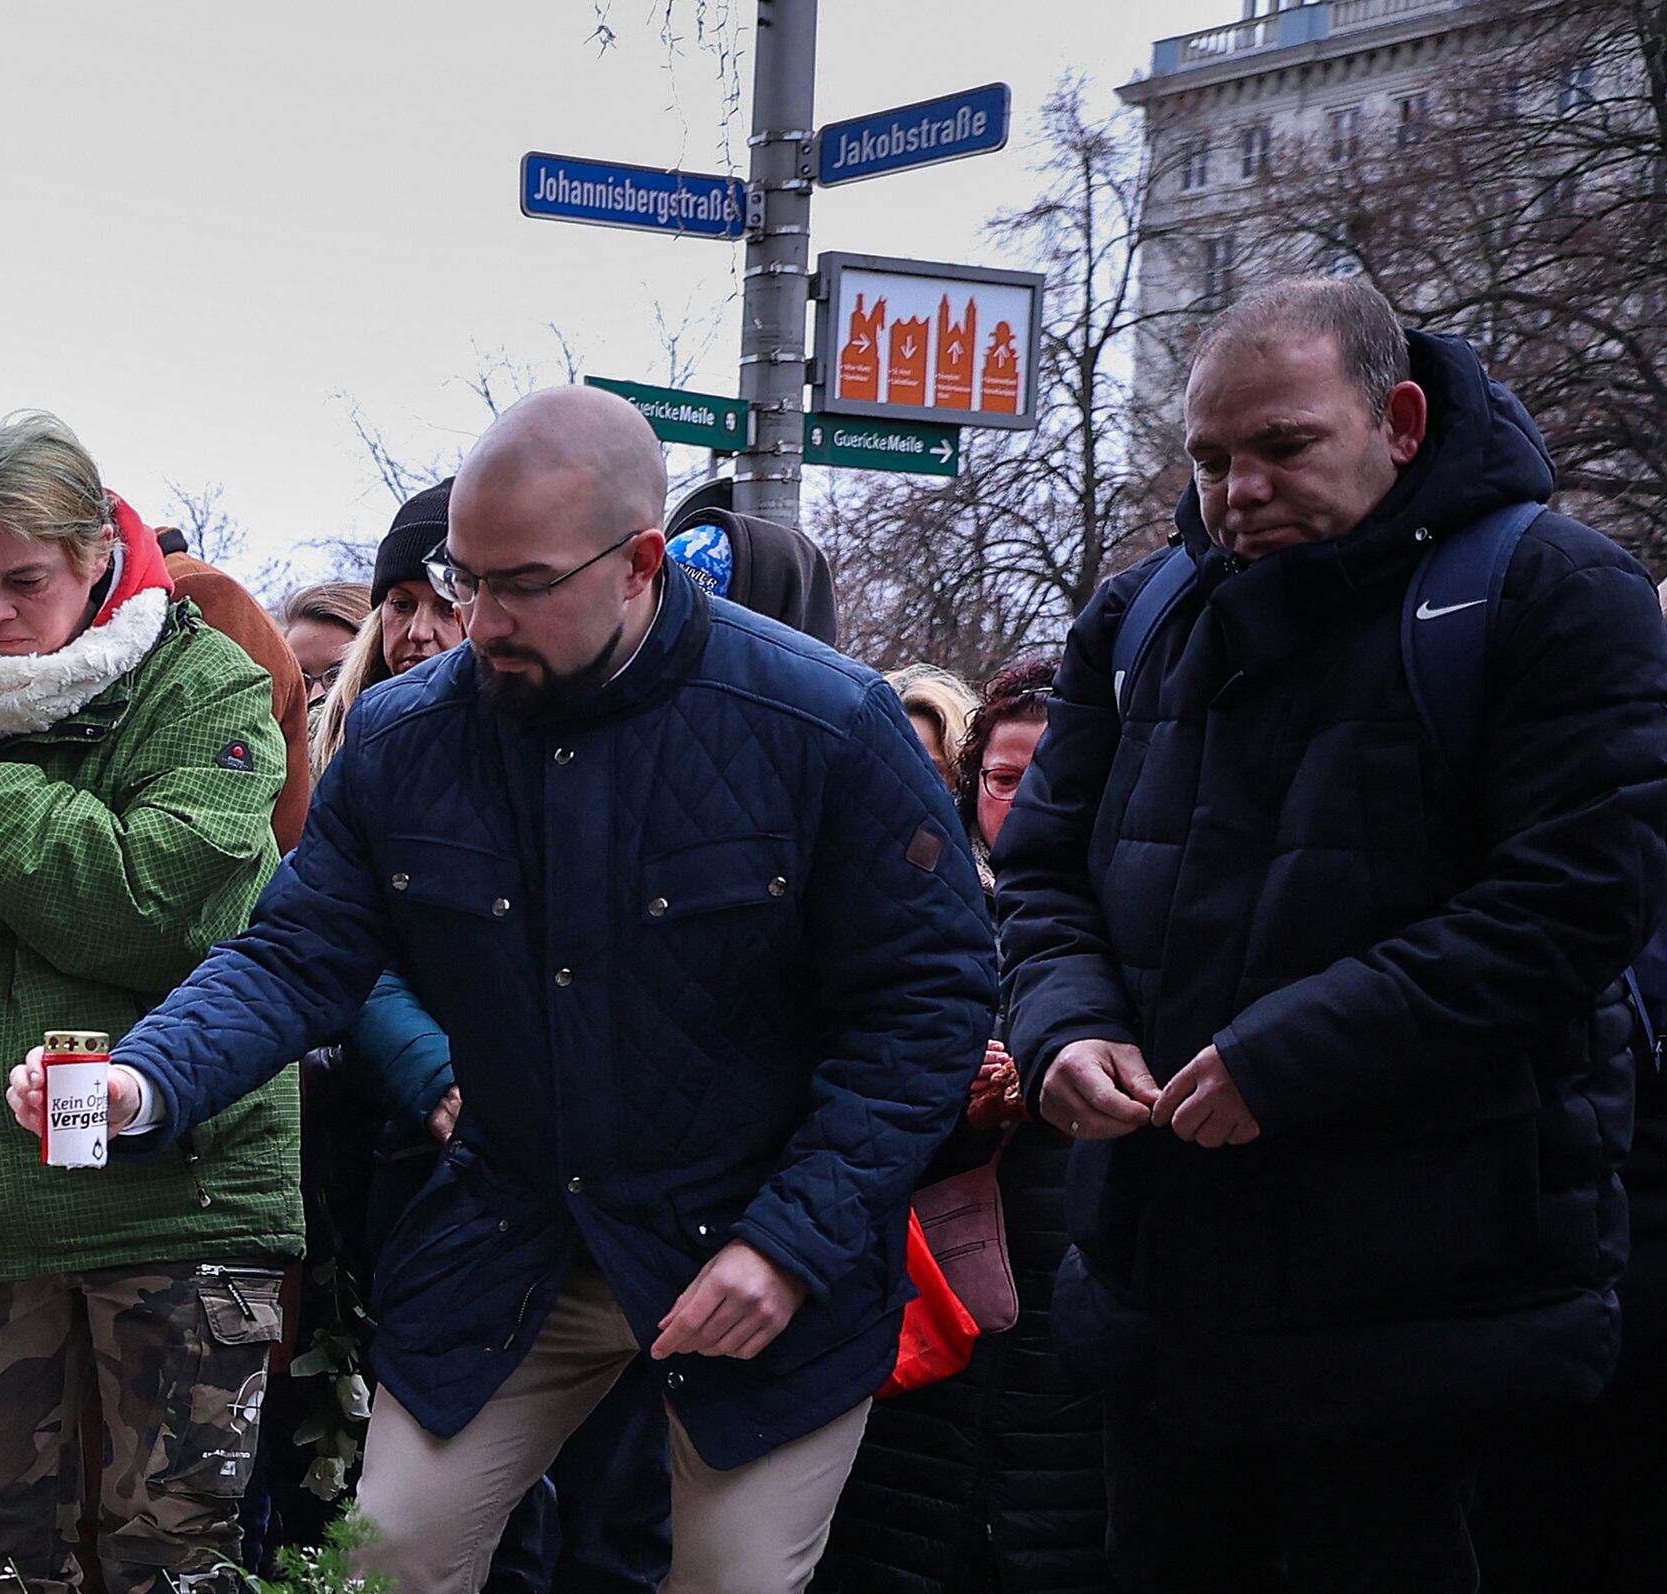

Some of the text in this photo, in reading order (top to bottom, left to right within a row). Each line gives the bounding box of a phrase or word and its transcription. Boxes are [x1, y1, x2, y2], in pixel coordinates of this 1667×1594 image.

[832, 105, 988, 170] Jakobstraße
[533, 168, 736, 224] Johannisbergstraße
[628, 397, 715, 426] uerickeMeile
[833, 429, 924, 455] GuerickeMeile
[51, 1095, 83, 1111] Kein
